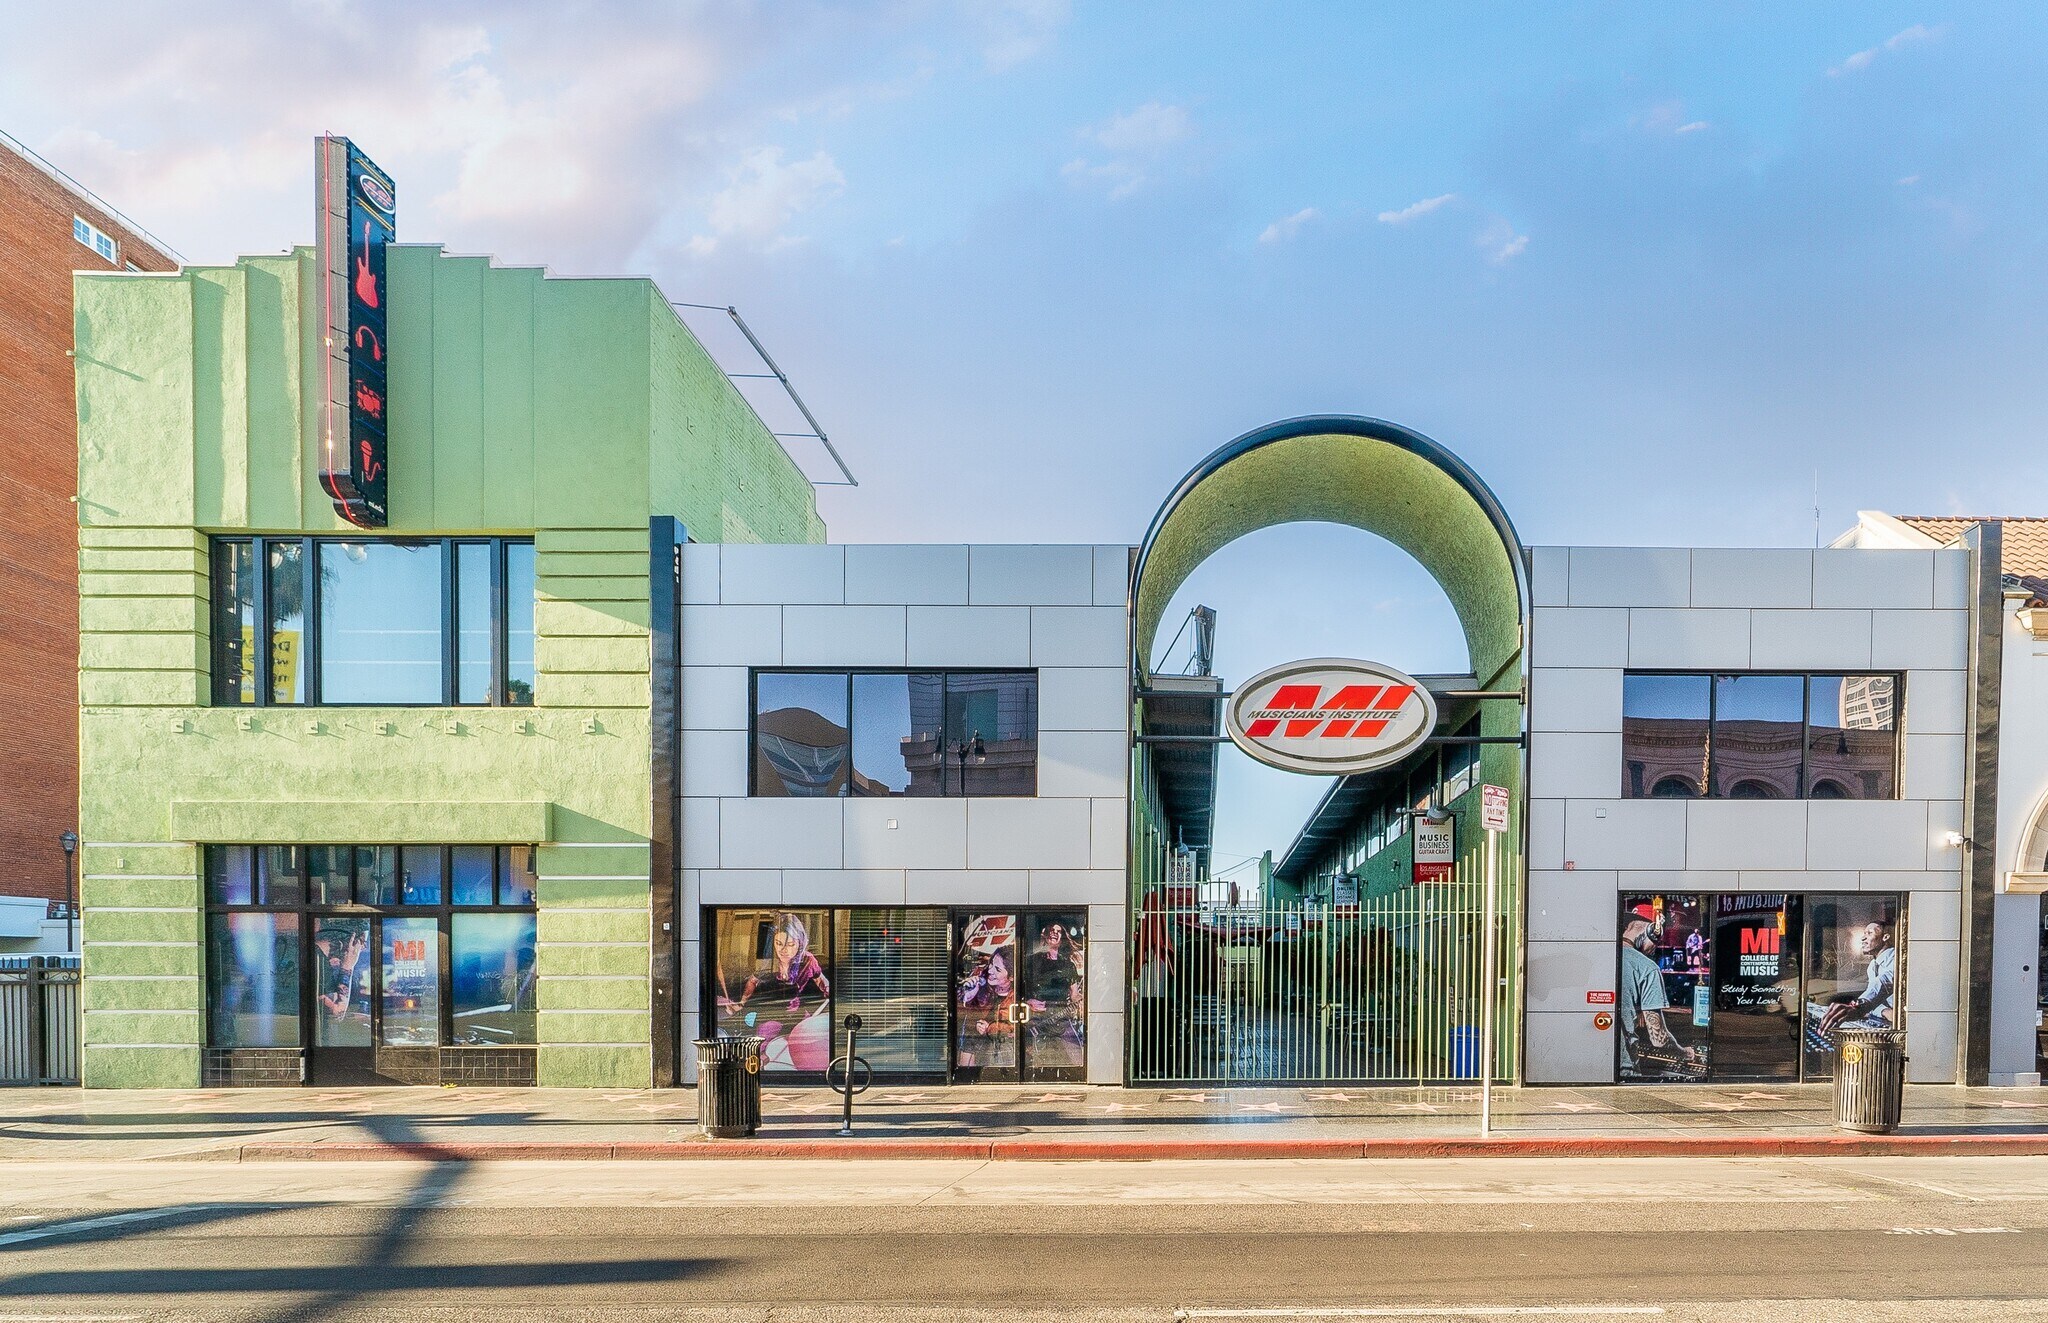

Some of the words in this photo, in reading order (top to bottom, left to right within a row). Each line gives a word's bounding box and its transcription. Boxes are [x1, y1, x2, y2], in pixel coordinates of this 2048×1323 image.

[1243, 685, 1416, 738] MI
[1247, 710, 1327, 719] MUSICIANS
[1328, 710, 1401, 719] INSTITUTE
[1419, 834, 1449, 842] MUSIC
[1741, 928, 1779, 954] MI
[394, 940, 425, 961] MI
[395, 969, 426, 978] MUSIC
[1740, 966, 1778, 976] MUSIC
[1721, 985, 1748, 995] Study
[1751, 985, 1797, 996] Something
[1736, 996, 1754, 1005] You
[1756, 996, 1781, 1005] Love!
